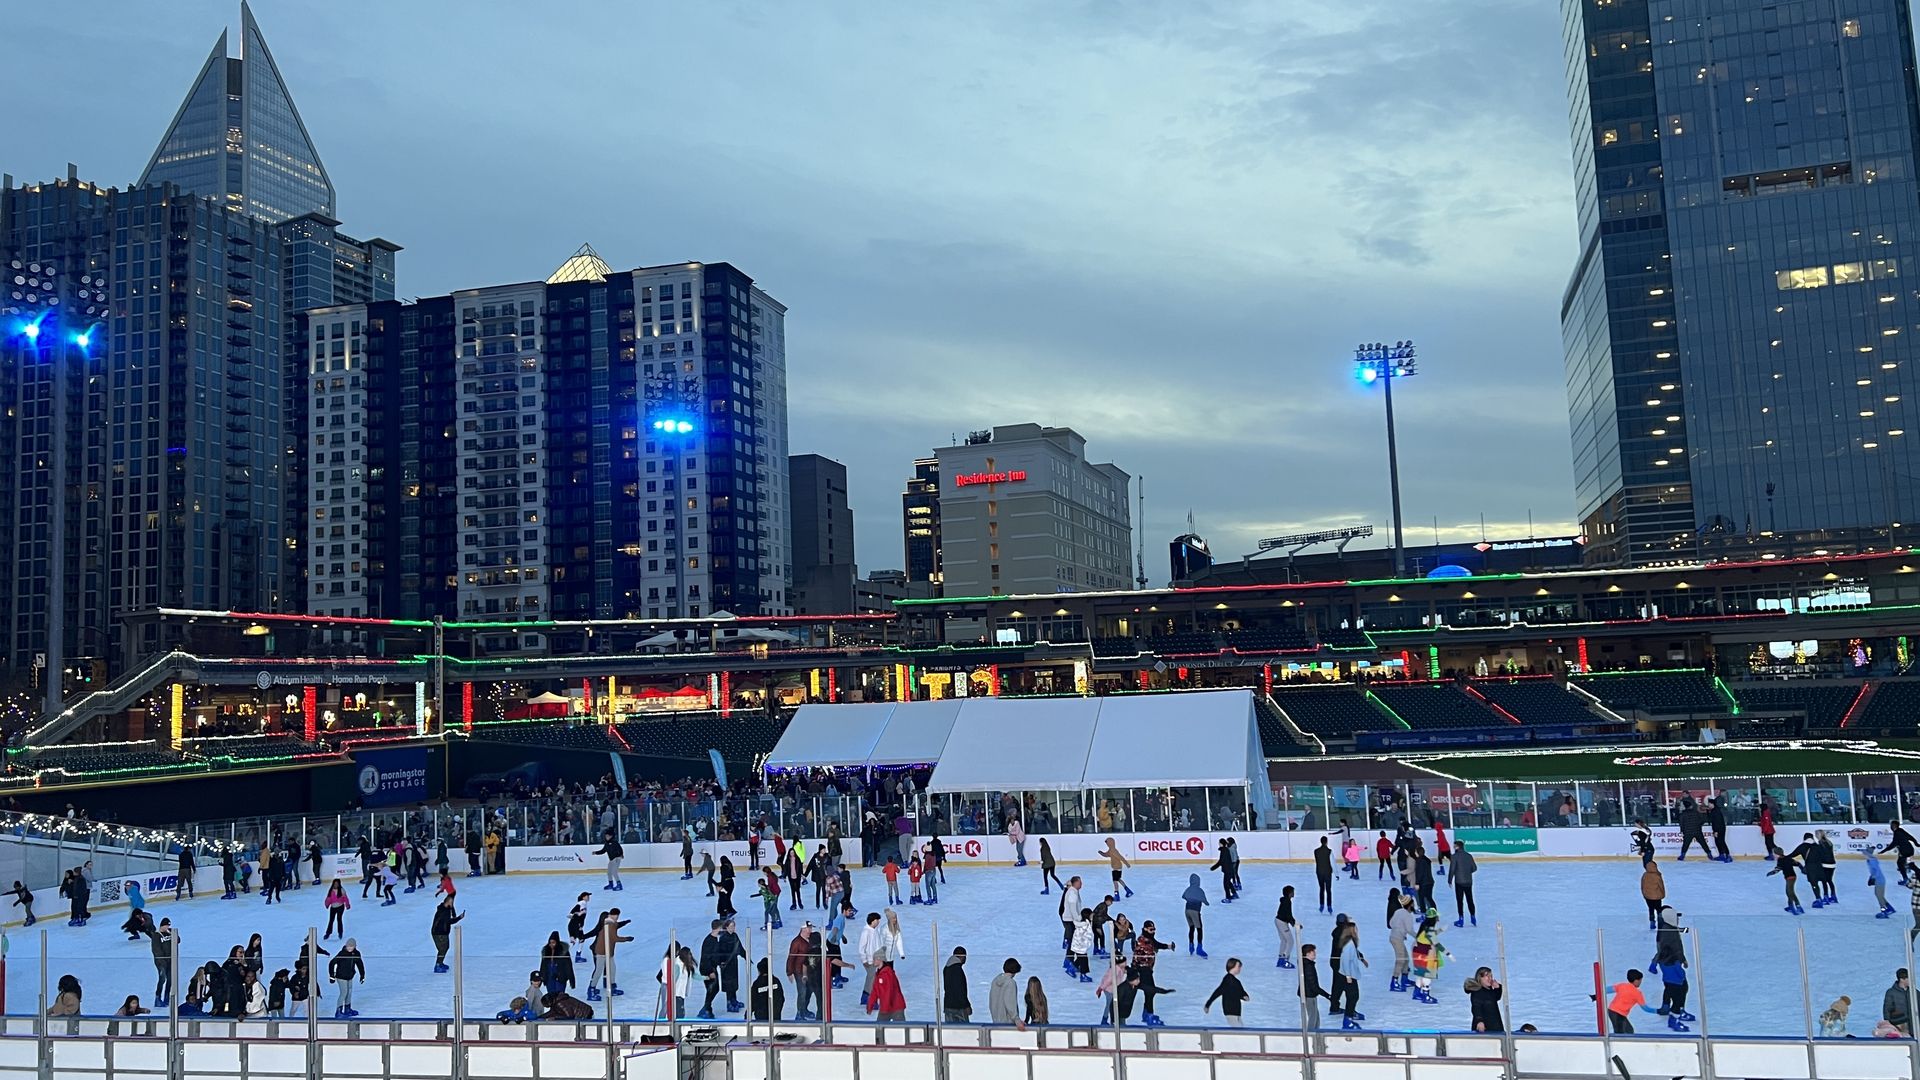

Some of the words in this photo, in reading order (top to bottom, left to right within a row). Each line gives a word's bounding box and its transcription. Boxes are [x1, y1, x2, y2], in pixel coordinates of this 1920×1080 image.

[956, 472, 1006, 487] Residence
[1008, 470, 1026, 482] Inn
[332, 675, 353, 684] Home
[354, 675, 368, 683] Run
[368, 674, 388, 684] Porch
[381, 768, 426, 780] morningstar
[381, 778, 425, 790] STORAGE
[1138, 840, 1183, 851] CIRCLE
[1187, 838, 1204, 855] K
[1515, 838, 1536, 846] joyfully
[965, 841, 981, 857] K
